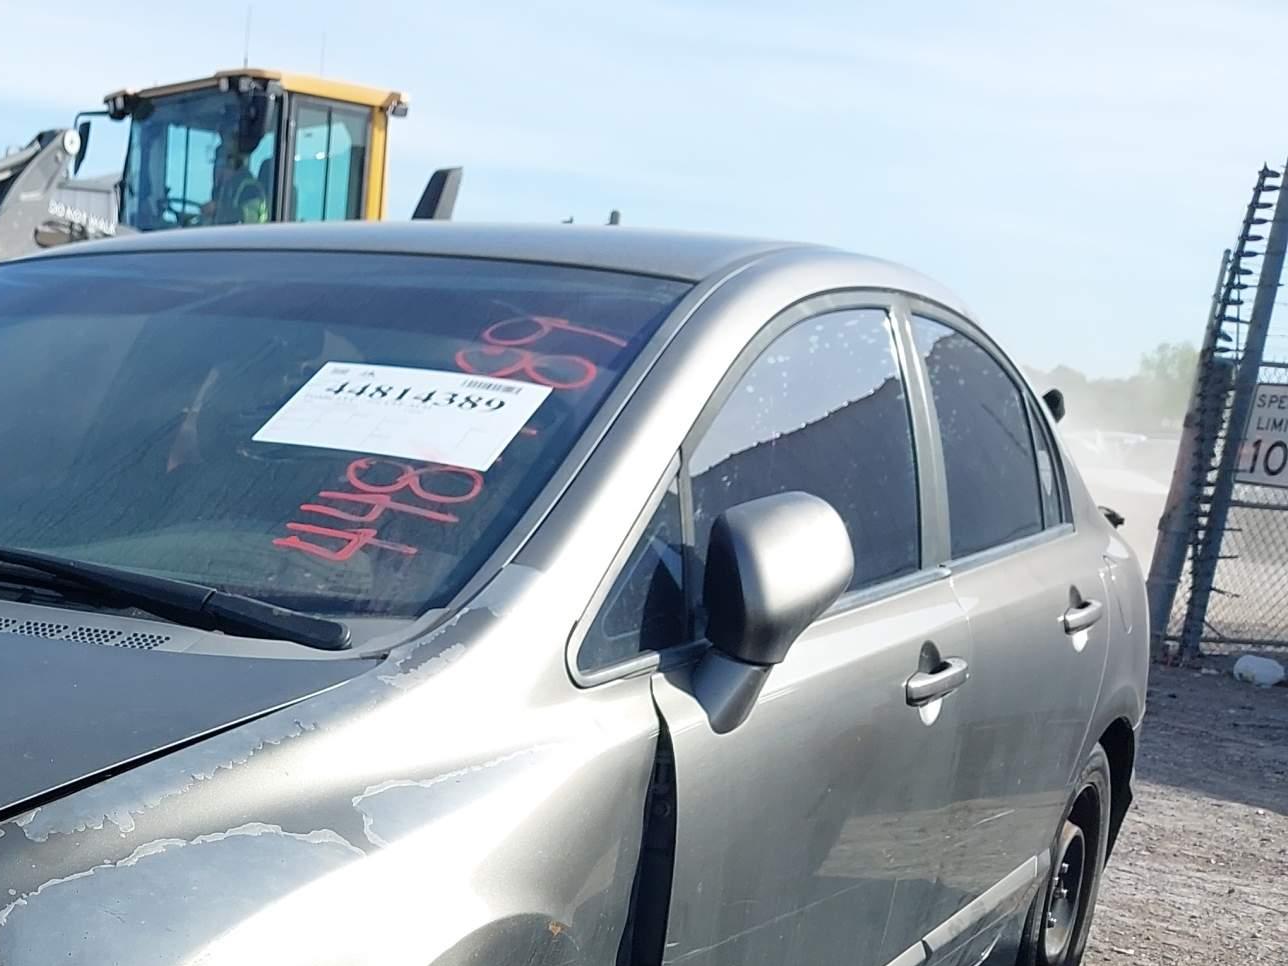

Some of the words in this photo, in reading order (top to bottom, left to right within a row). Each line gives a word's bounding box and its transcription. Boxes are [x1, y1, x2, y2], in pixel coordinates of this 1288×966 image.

[325, 380, 506, 412] 44814389
[1256, 393, 1288, 410] SPE
[1256, 415, 1288, 433] LIMI
[1249, 438, 1288, 476] 10
